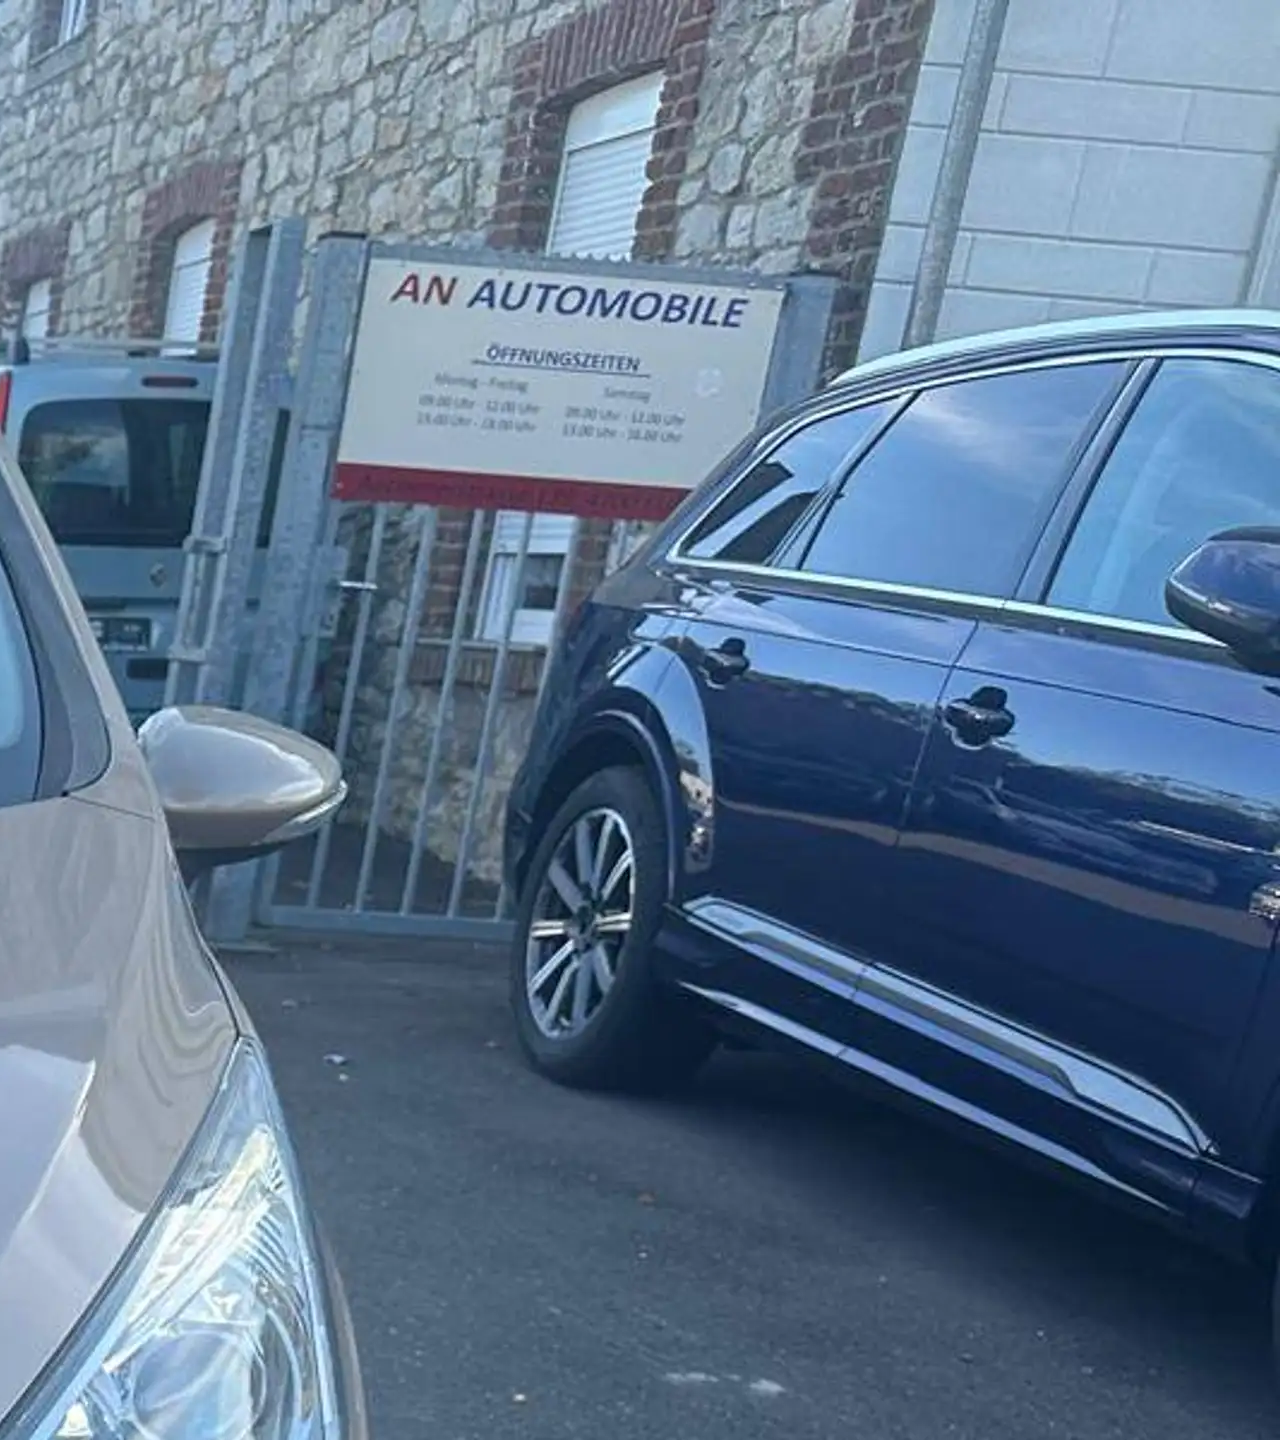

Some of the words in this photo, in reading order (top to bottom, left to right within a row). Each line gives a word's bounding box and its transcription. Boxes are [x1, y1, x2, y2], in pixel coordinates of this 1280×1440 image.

[390, 274, 458, 306] AN
[467, 279, 750, 328] AUTOMOBILE
[486, 343, 641, 372] ÖFFNUNGSZEITEN
